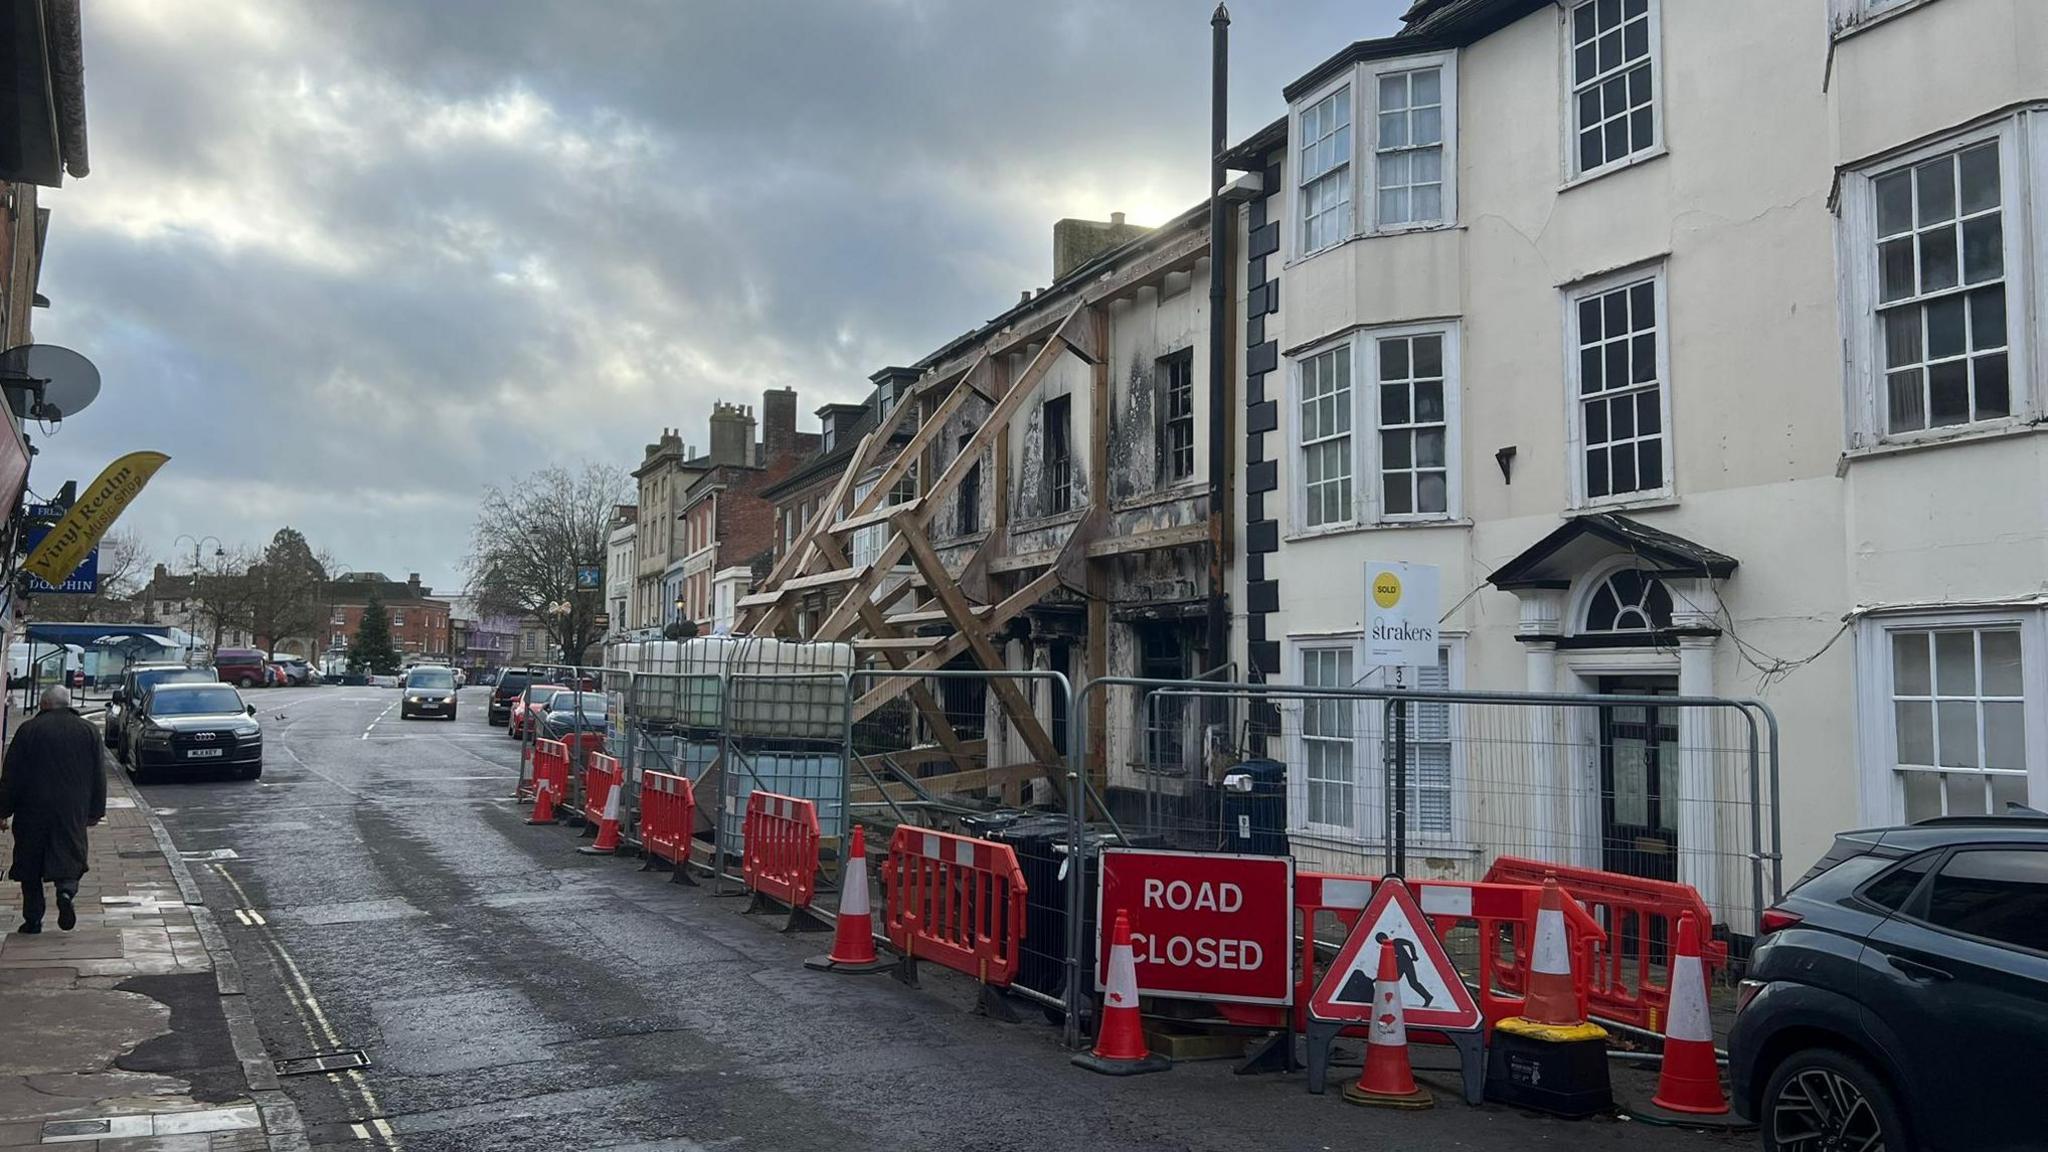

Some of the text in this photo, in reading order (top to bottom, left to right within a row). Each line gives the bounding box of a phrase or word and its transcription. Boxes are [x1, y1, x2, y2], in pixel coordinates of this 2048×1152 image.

[37, 466, 132, 570] Vinyl Realm
[82, 476, 142, 541] Music Shop
[1377, 585, 1397, 594] SOLD
[1372, 621, 1432, 641] strakers
[1144, 878, 1243, 913] ROAD
[1130, 932, 1263, 971] CLOSED
